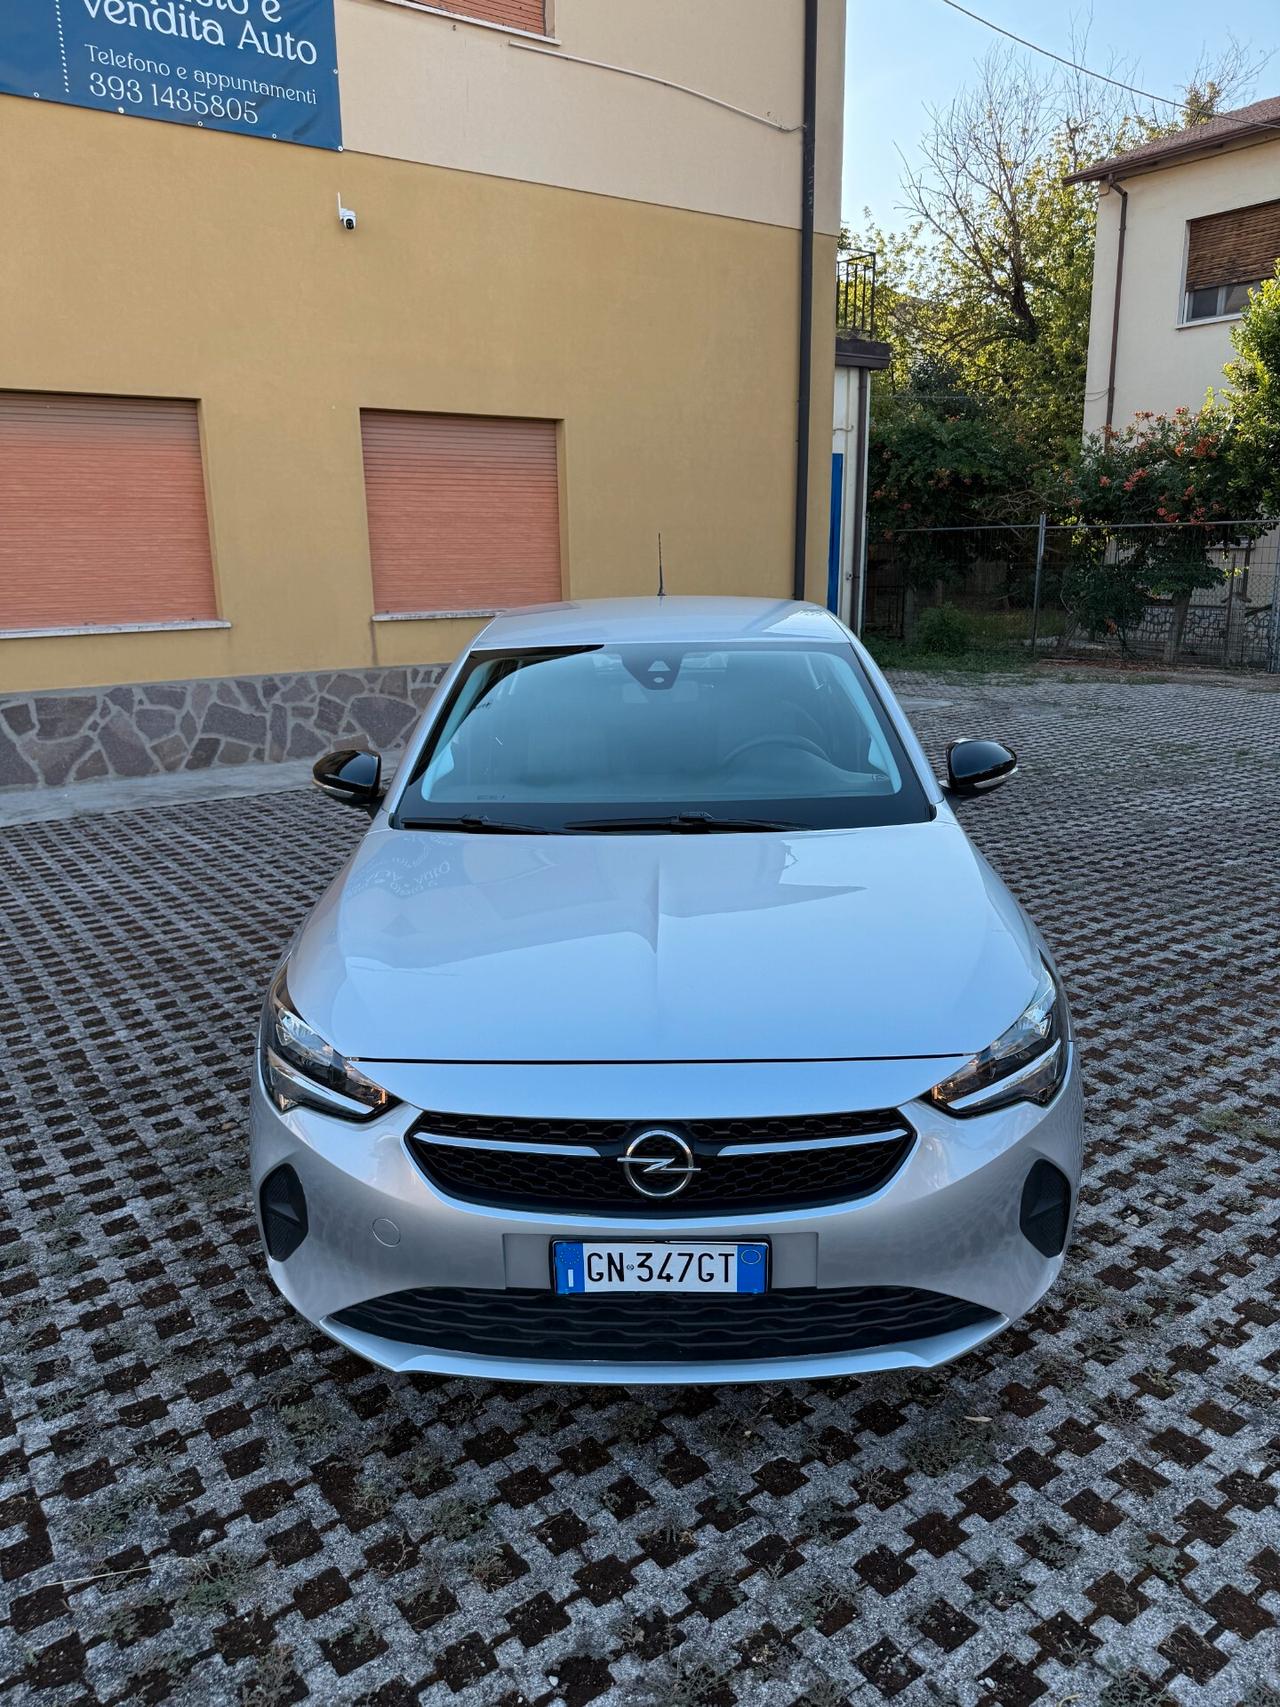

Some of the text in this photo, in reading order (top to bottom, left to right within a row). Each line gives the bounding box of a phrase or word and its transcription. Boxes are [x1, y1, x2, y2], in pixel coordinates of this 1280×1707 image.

[83, 0, 318, 65] Vendita Auto
[84, 43, 317, 105] Telefono e appuntamenti
[89, 72, 258, 124] 393 1435805
